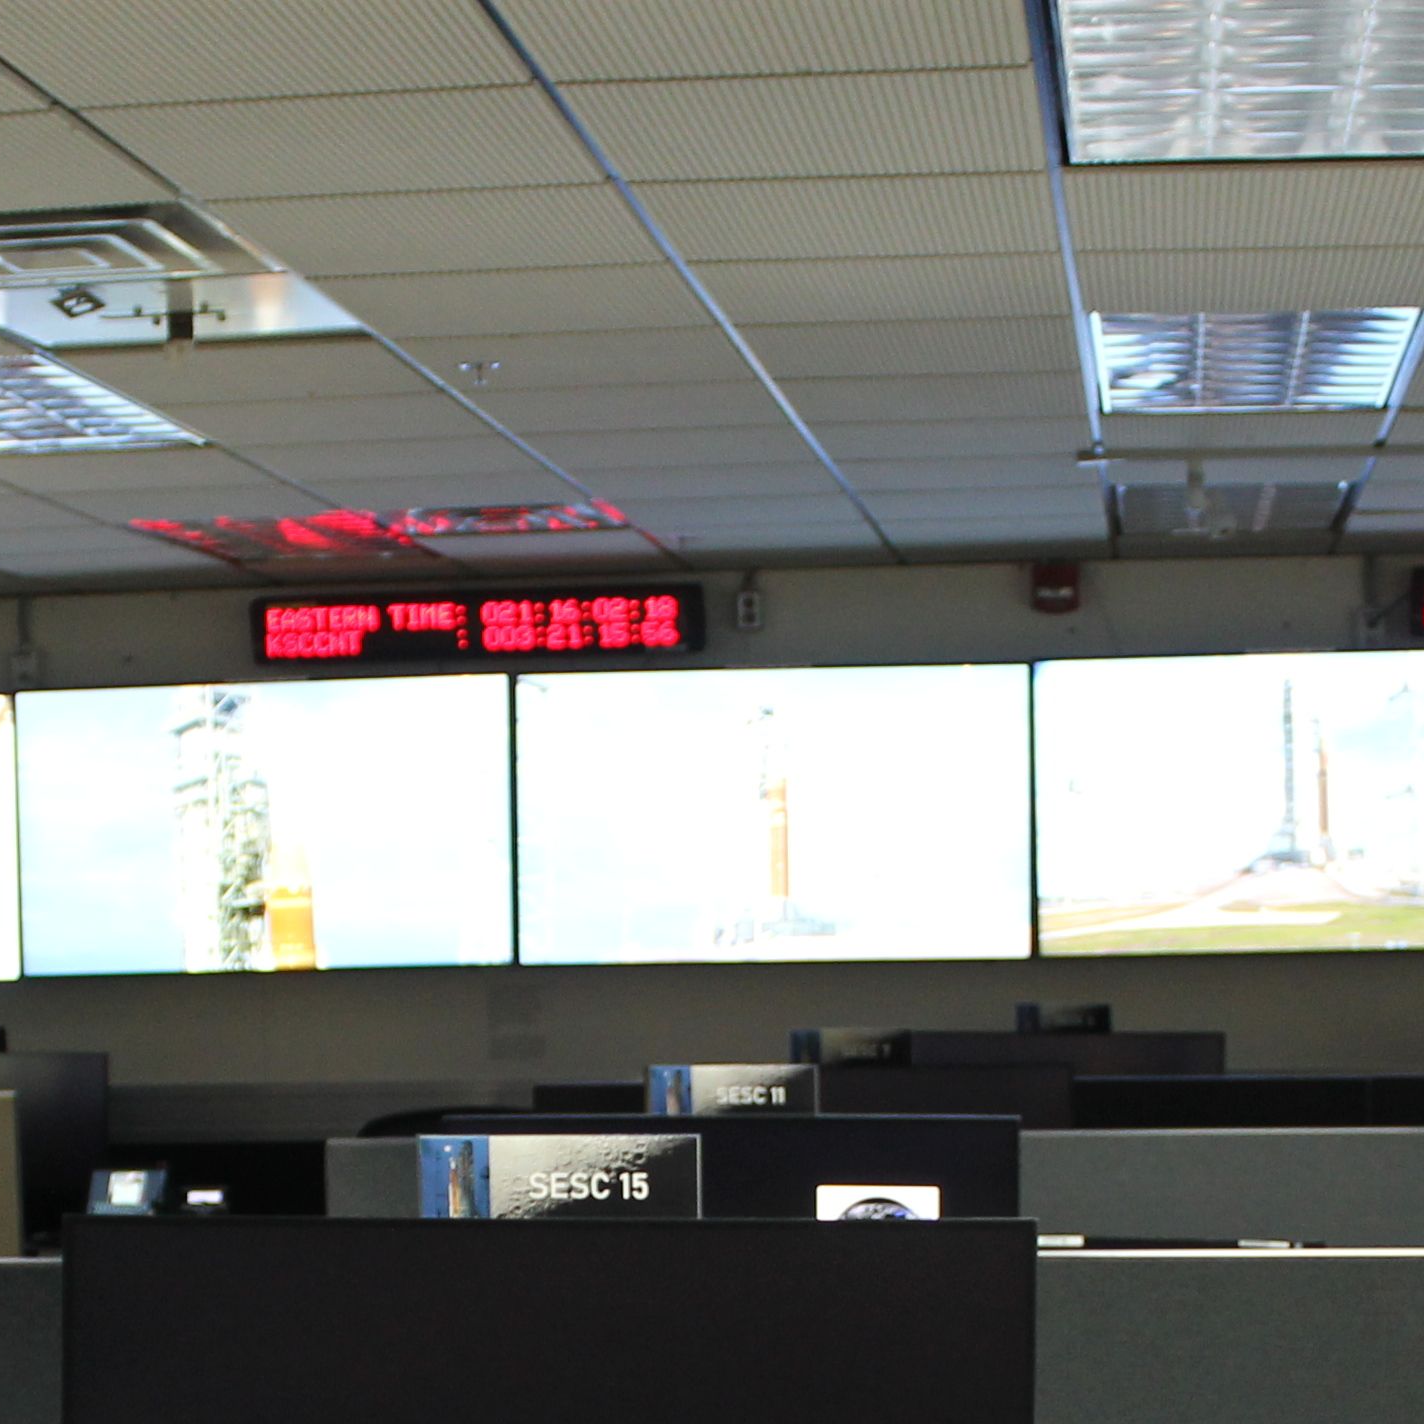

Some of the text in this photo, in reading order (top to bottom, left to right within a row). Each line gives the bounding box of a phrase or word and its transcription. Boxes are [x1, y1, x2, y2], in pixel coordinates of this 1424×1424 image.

[266, 606, 380, 633] EASTERN
[716, 1085, 786, 1106] SESC 11
[528, 1172, 649, 1200] SESC 15
